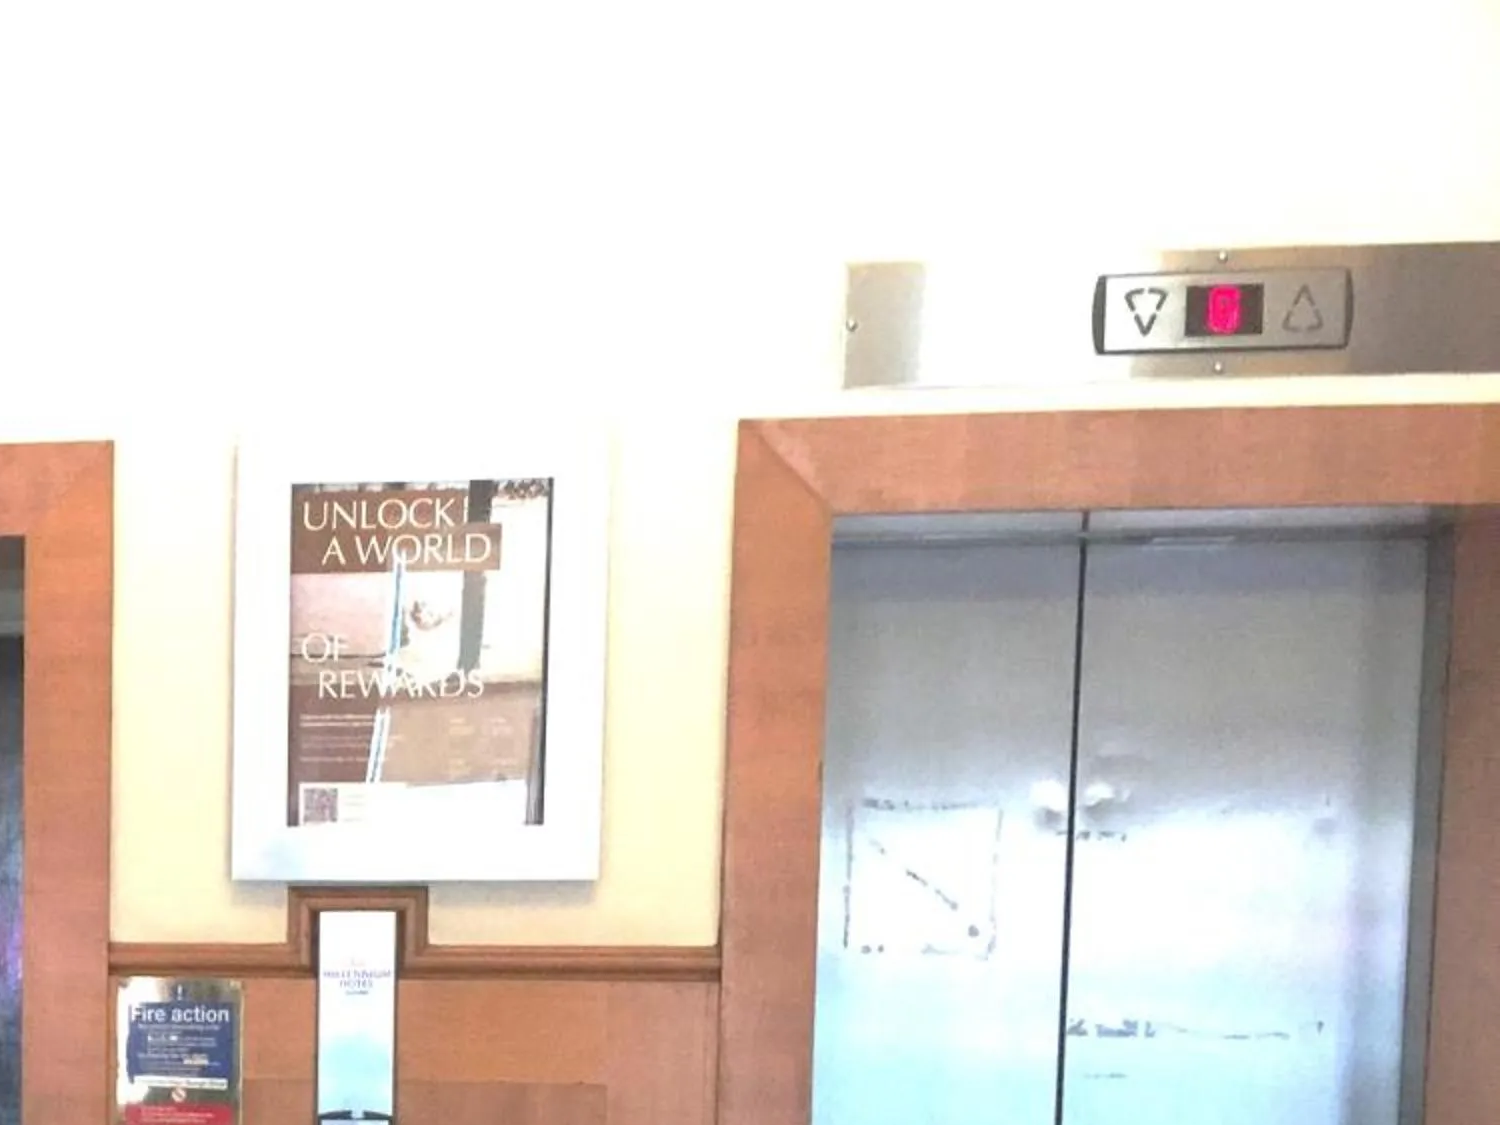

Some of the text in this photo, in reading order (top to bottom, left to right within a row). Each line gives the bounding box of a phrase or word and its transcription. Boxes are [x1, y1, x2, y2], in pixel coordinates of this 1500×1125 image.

[303, 498, 455, 530] UNLOCK
[323, 533, 491, 565] A WORLD
[303, 632, 349, 663] OF
[131, 1005, 230, 1022] Fire action
